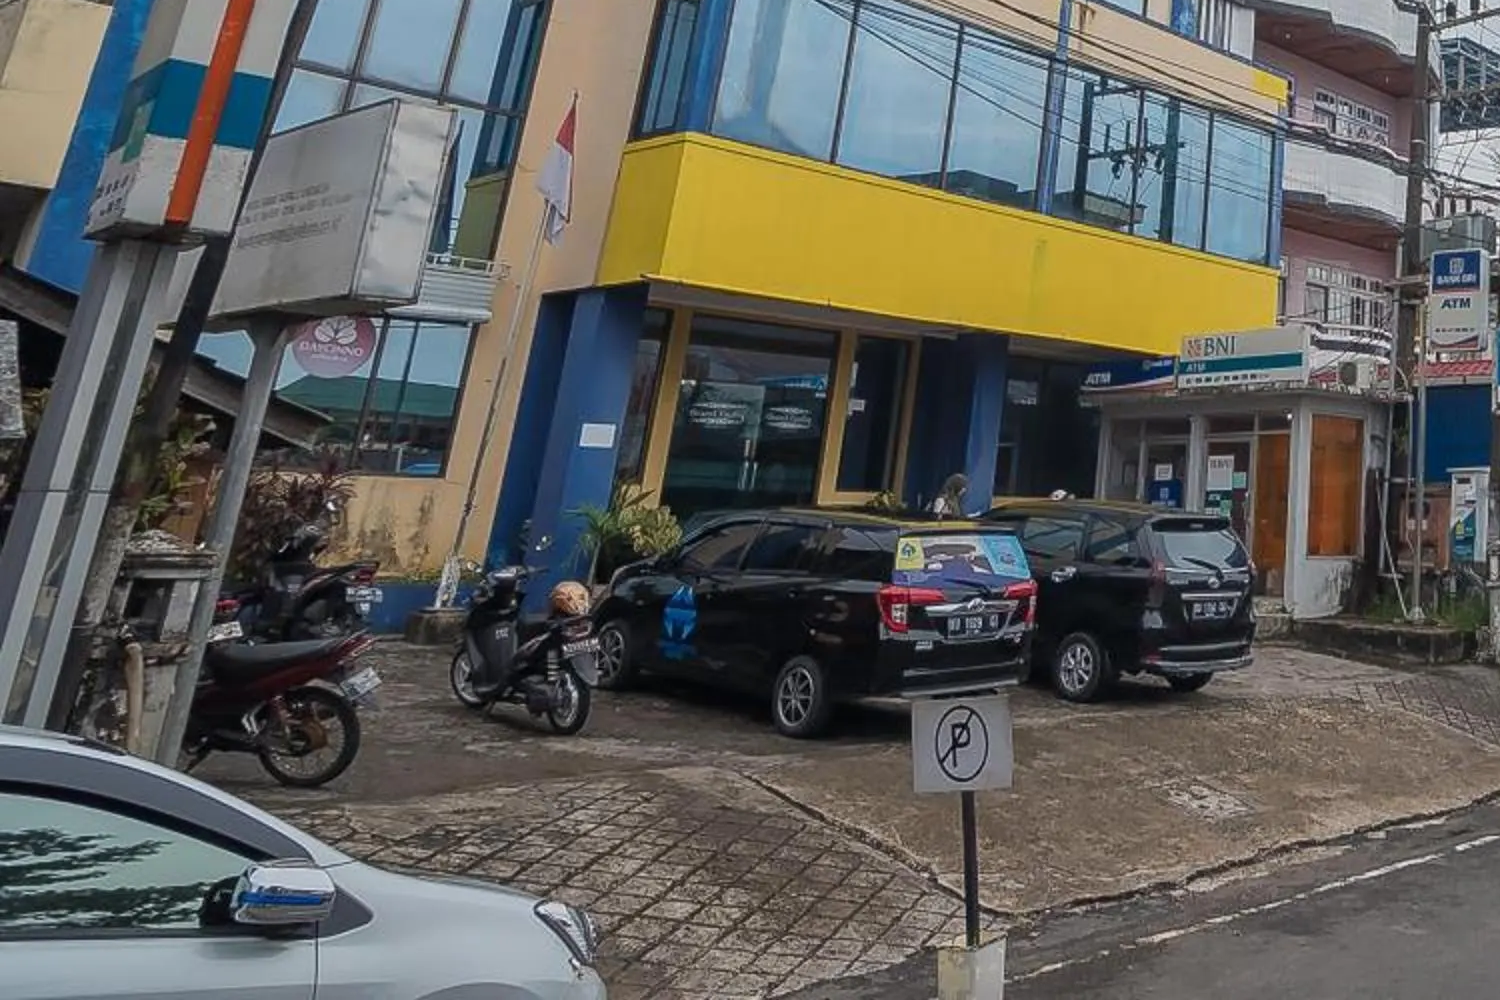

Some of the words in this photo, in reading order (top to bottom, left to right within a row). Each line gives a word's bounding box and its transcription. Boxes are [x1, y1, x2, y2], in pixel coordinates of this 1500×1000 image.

[1440, 297, 1471, 309] ATM
[1203, 335, 1237, 355] BNI
[1084, 372, 1112, 385] ATM
